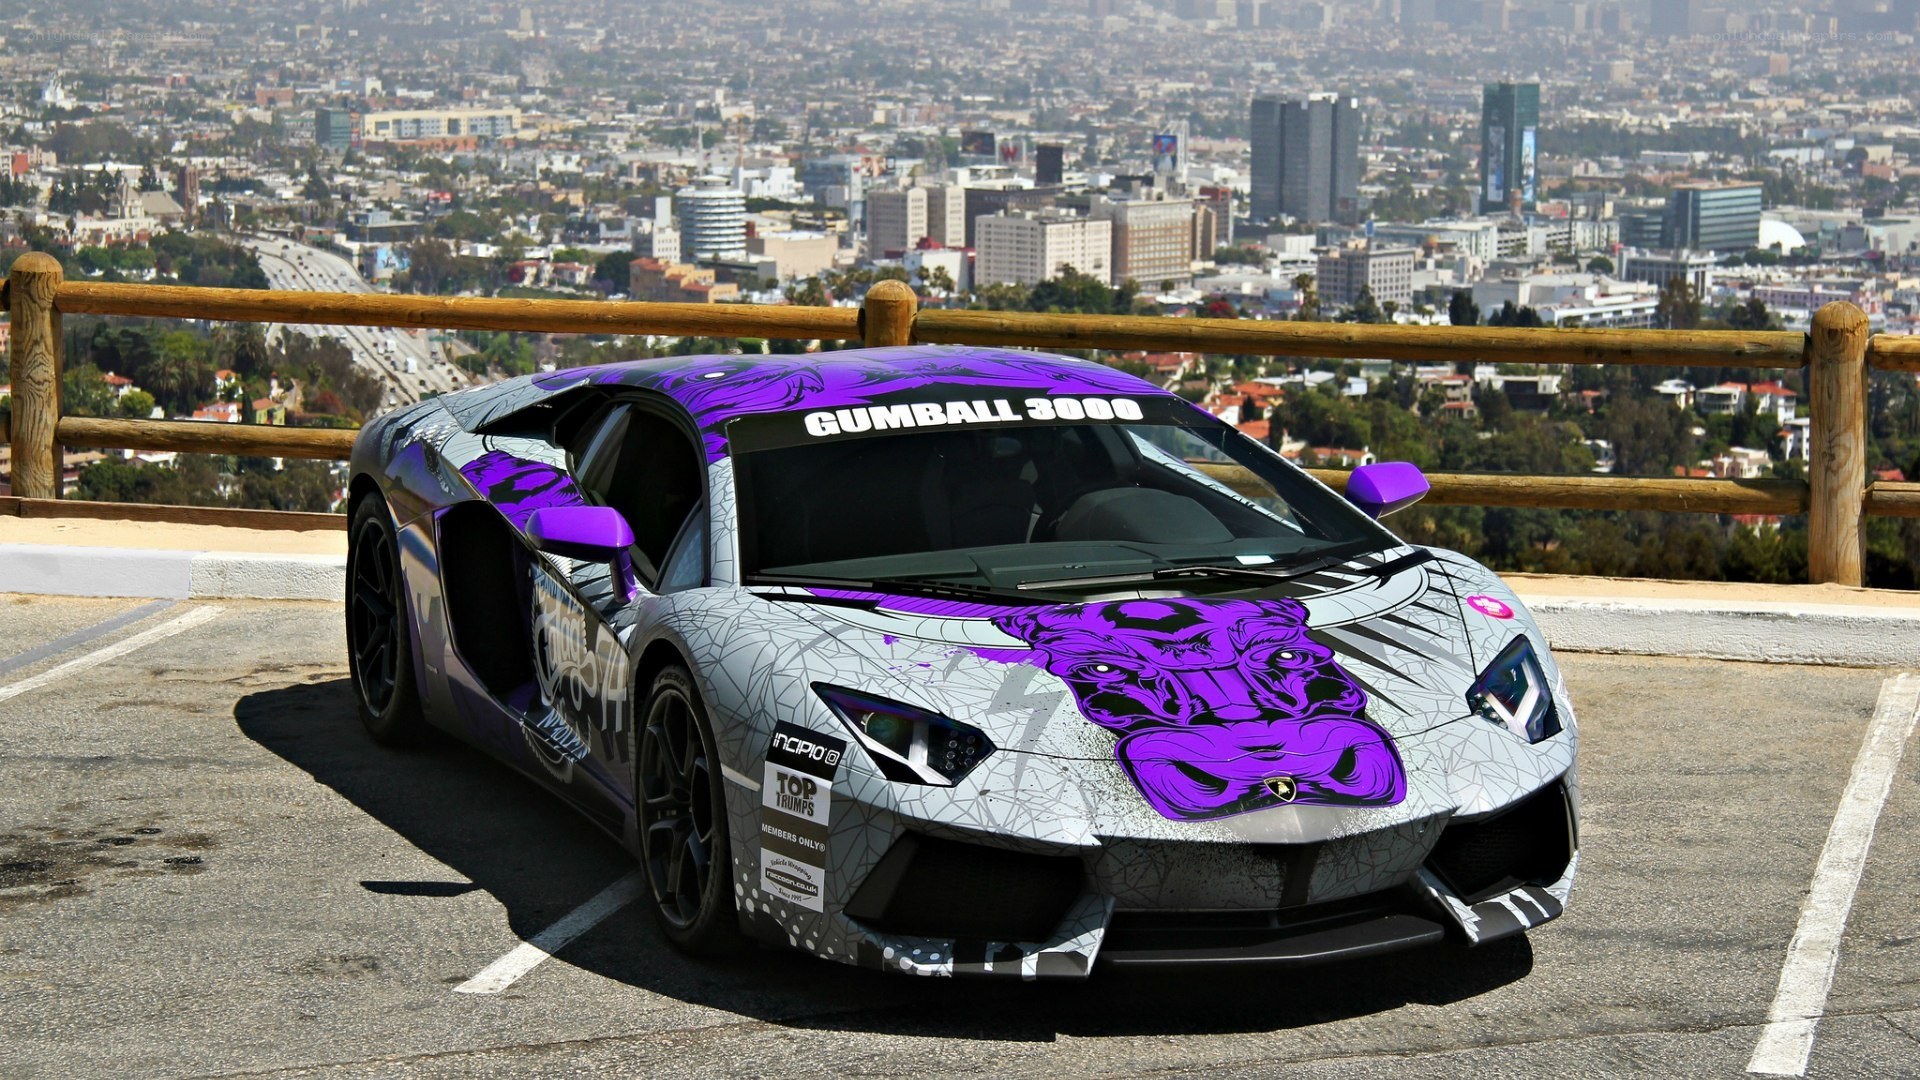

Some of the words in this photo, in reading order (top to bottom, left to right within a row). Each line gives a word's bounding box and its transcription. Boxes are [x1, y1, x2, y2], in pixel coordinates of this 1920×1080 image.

[804, 399, 1023, 437] GUMBALL
[1024, 398, 1143, 420] 3000
[776, 770, 817, 800] TOP
[776, 792, 814, 817] TRUMPS
[761, 823, 797, 843] MEMBERS
[766, 870, 817, 894] raccoon.co.uk
